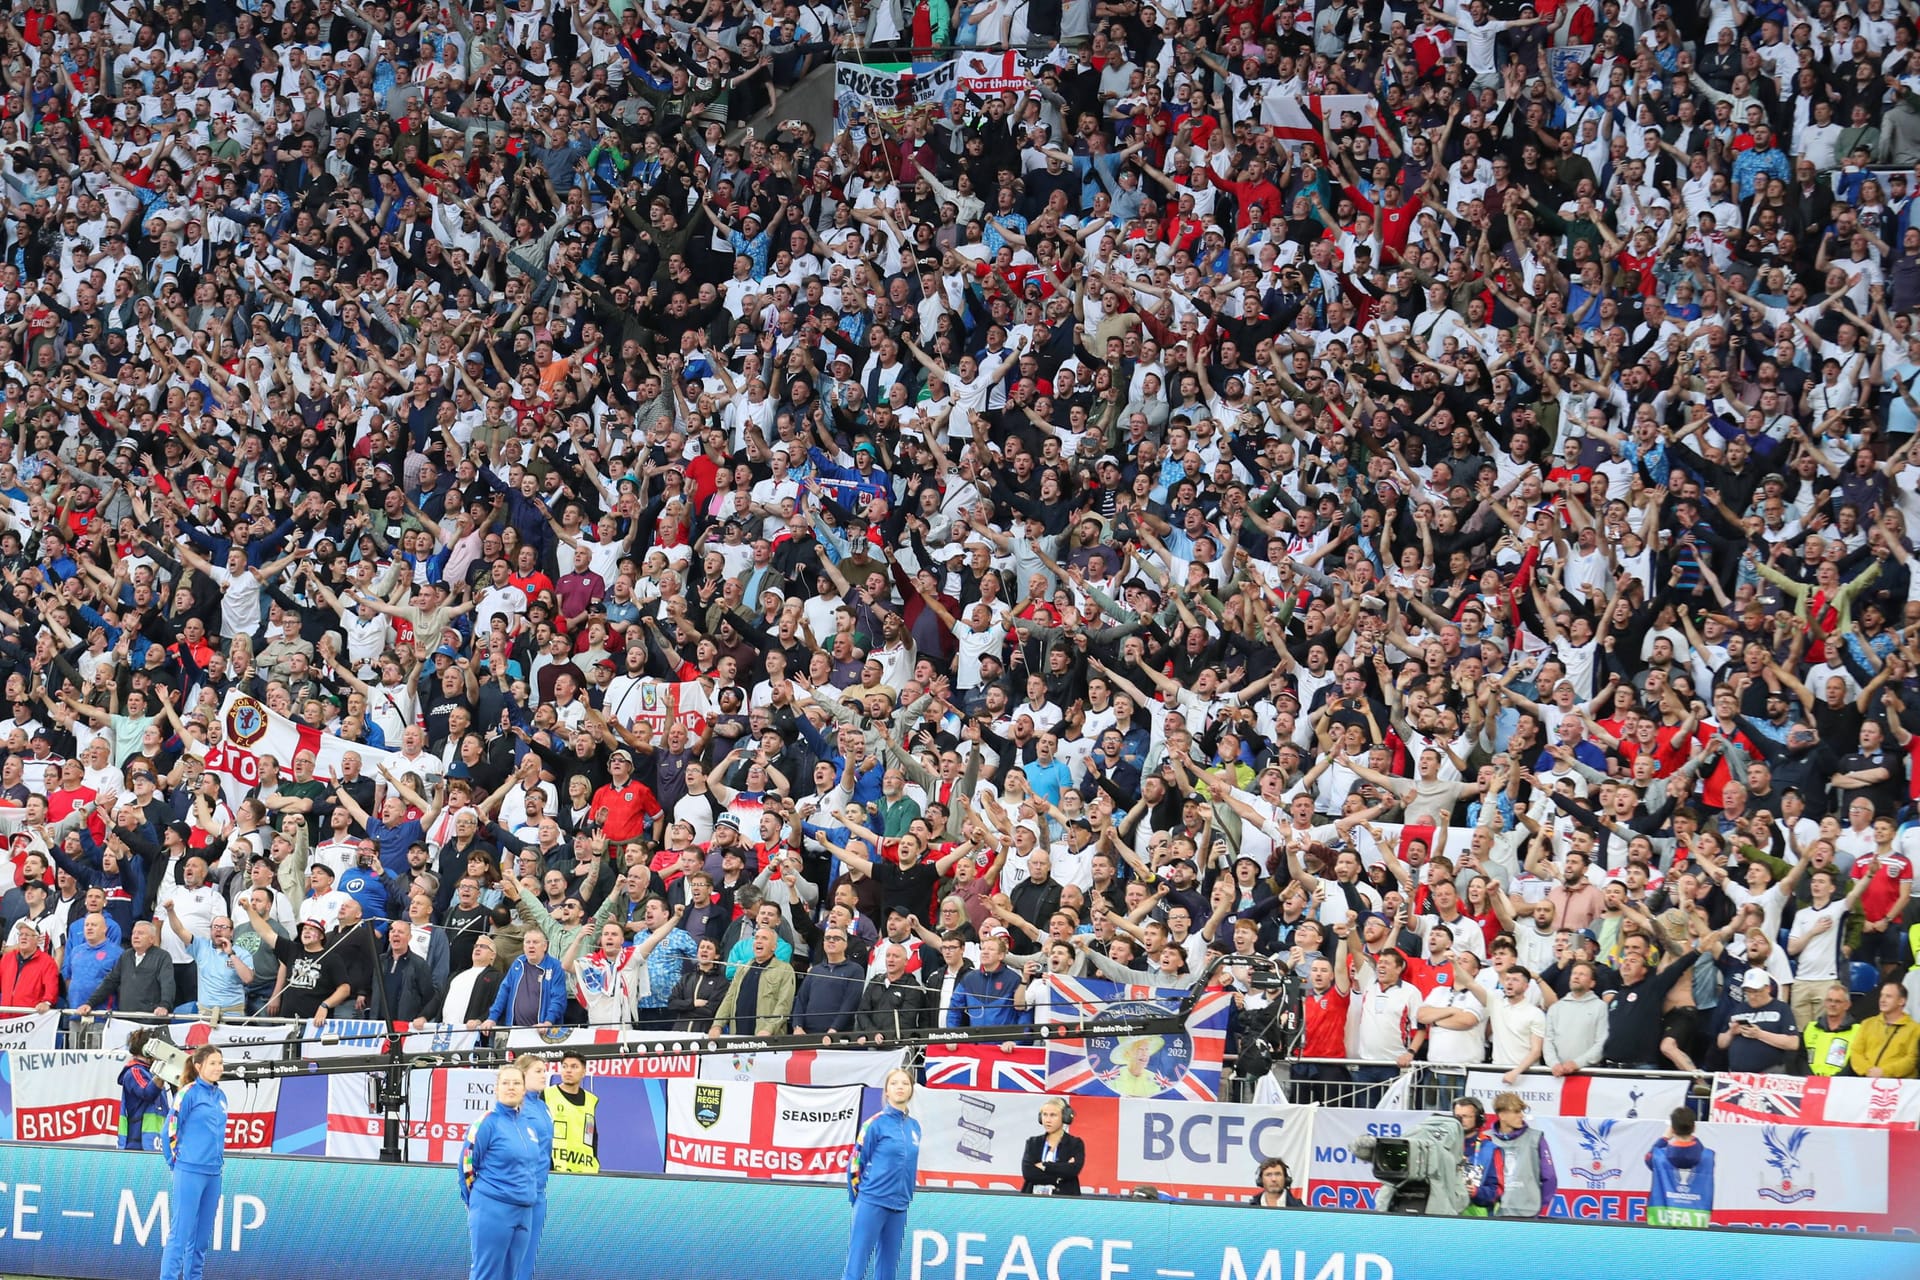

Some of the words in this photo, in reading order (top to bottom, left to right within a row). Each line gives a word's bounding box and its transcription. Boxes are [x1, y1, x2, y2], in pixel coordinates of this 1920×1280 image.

[968, 78, 1035, 91] Northampt
[19, 1053, 56, 1071] NEW
[638, 1056, 691, 1073] TOWN
[467, 1082, 494, 1095] ENG
[697, 1087, 720, 1098] LYME
[696, 1095, 719, 1105] REGIS
[22, 1104, 119, 1140] BRISTOL
[781, 1108, 855, 1123] SEASIDERS
[1143, 1112, 1285, 1165] BCFC
[553, 1147, 594, 1168] TEWAR
[669, 1139, 727, 1165] LYME
[733, 1147, 803, 1171] REGIS
[808, 1150, 850, 1172] AFC
[0, 1181, 43, 1241] E
[911, 1229, 1133, 1280] PEACE
